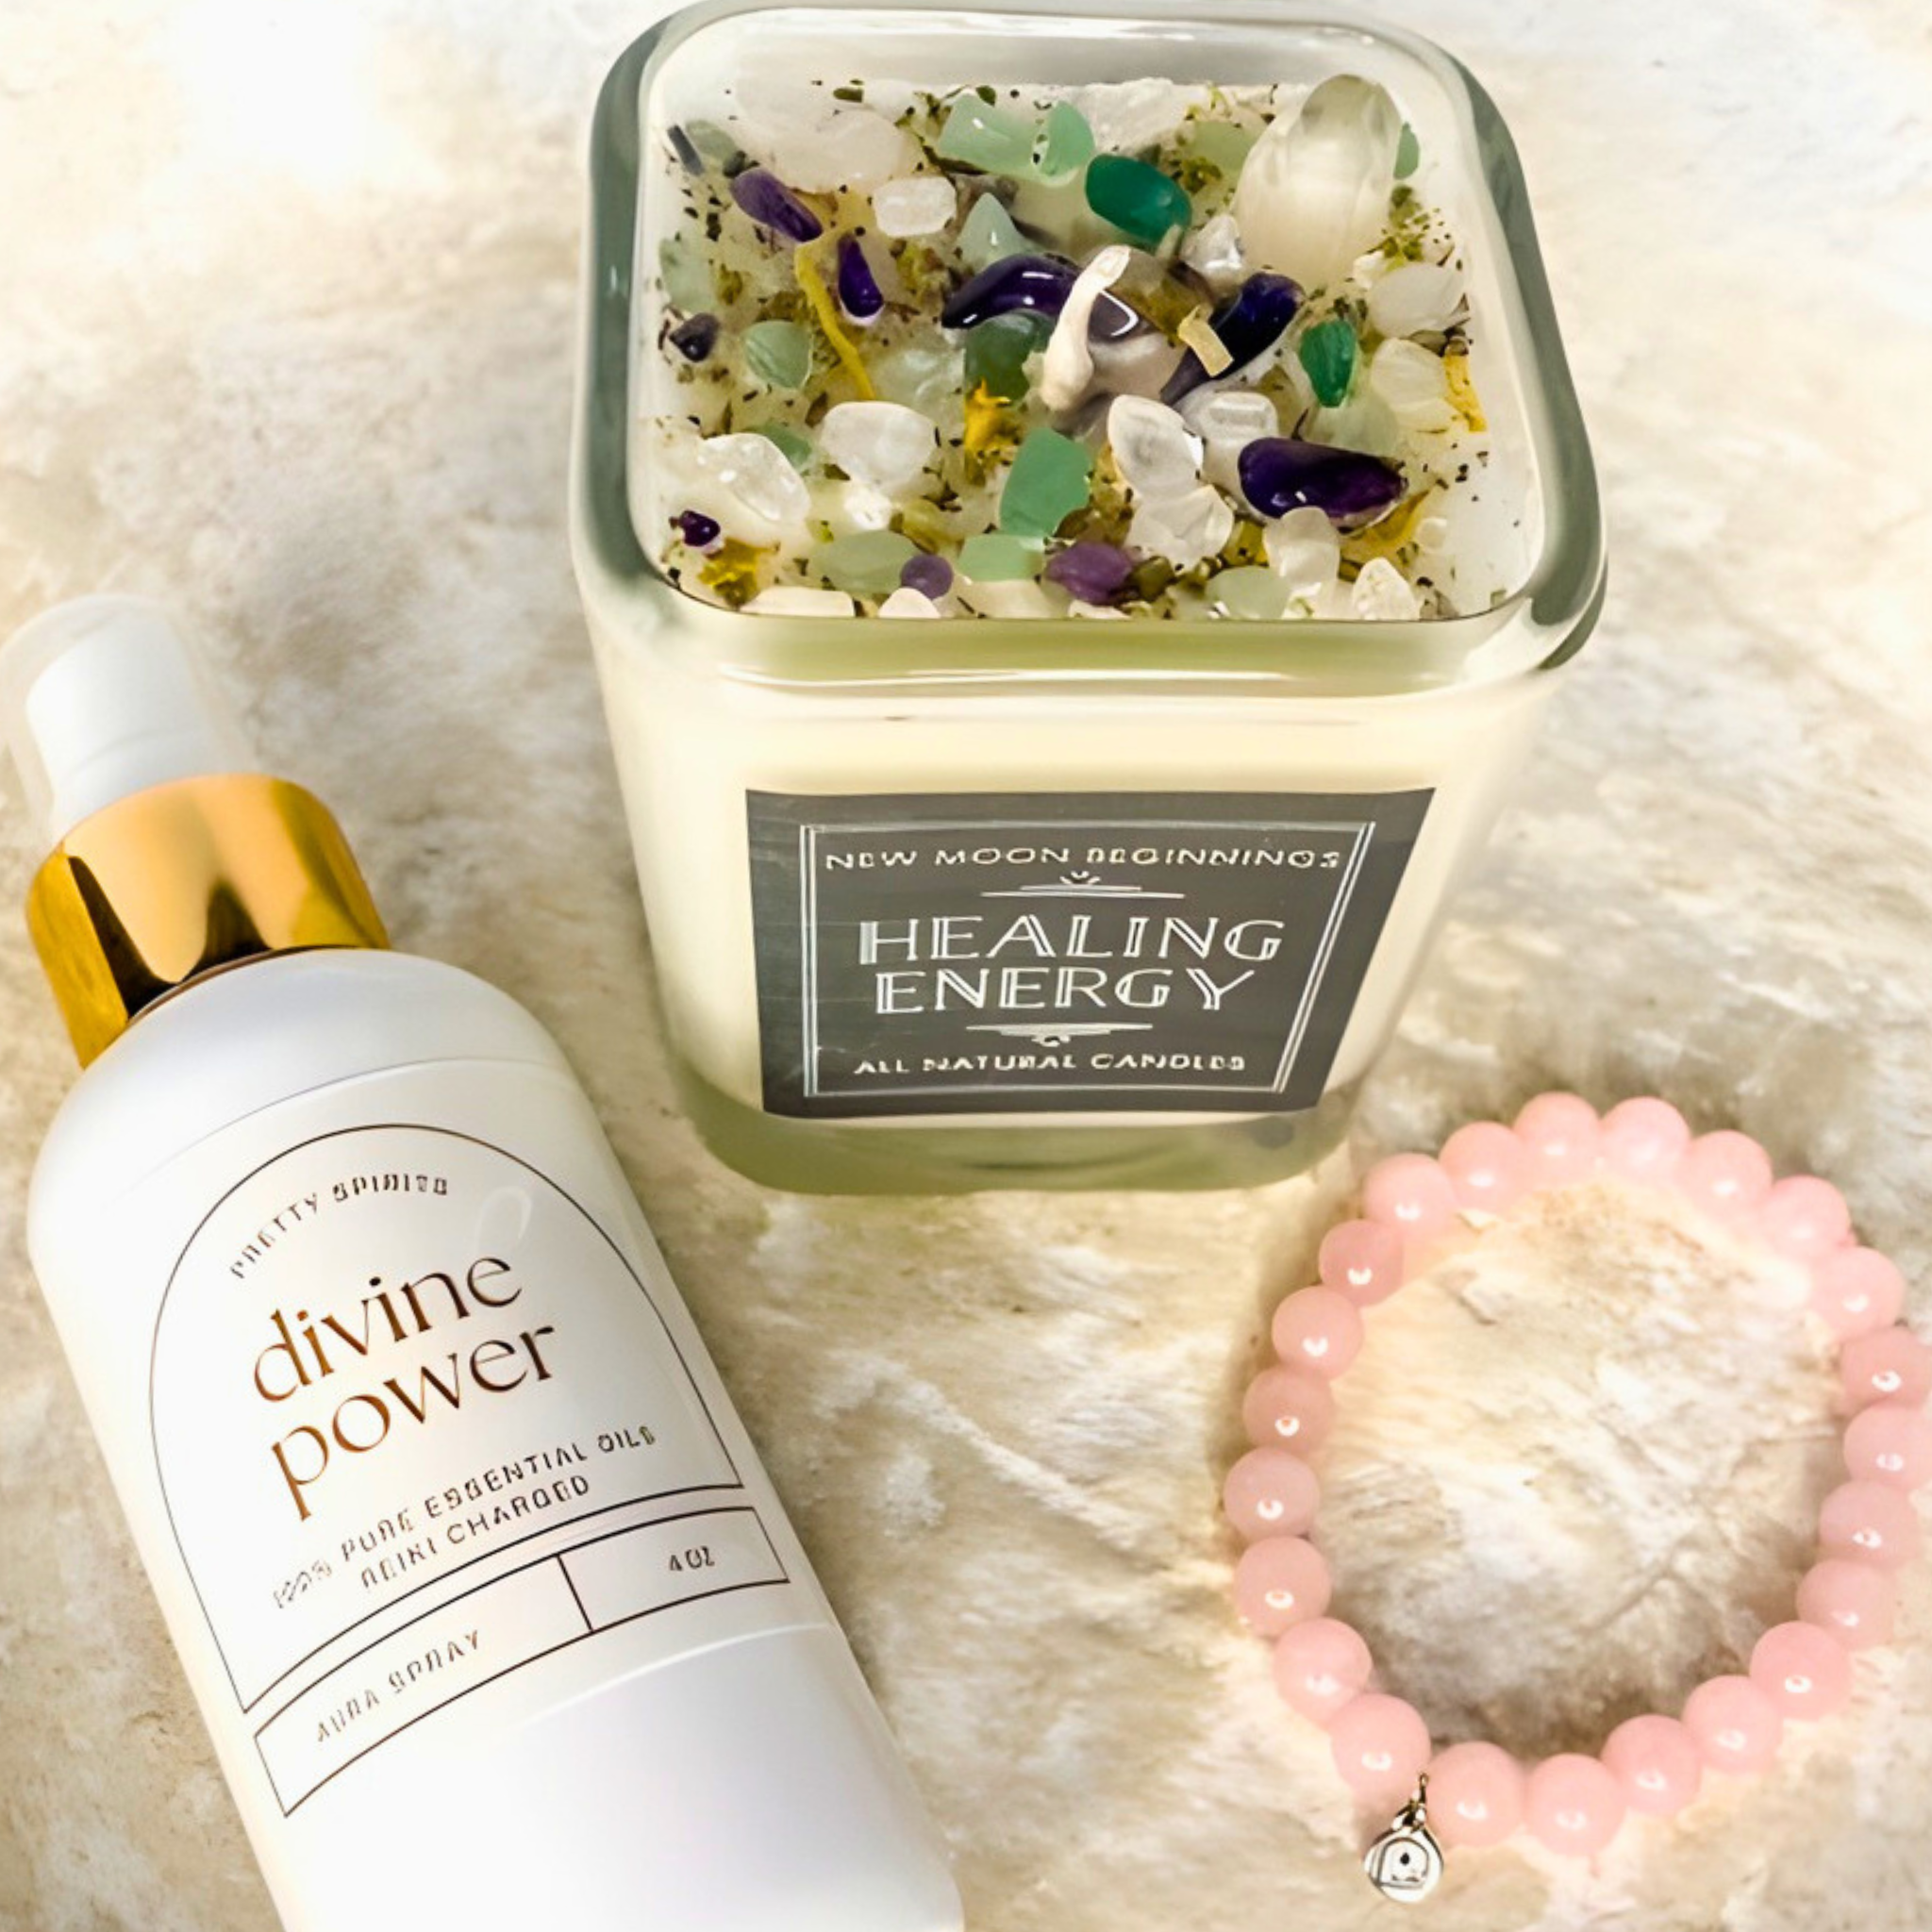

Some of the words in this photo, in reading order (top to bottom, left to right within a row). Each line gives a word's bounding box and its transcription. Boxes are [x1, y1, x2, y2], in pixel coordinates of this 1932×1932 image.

[826, 852, 916, 869] NEW
[935, 848, 1070, 865] MOON
[1088, 849, 1341, 868] BEGINNINGS
[859, 915, 1284, 964] HEALING
[874, 967, 1254, 1014] ENERGY
[854, 1059, 908, 1074] ALL
[923, 1054, 1075, 1072] NATURAL
[1091, 1054, 1244, 1071] CANDLES
[253, 1257, 523, 1402] divine
[271, 1325, 555, 1521] power
[425, 1441, 588, 1518] ESSENTIAL
[598, 1425, 656, 1452] OILS
